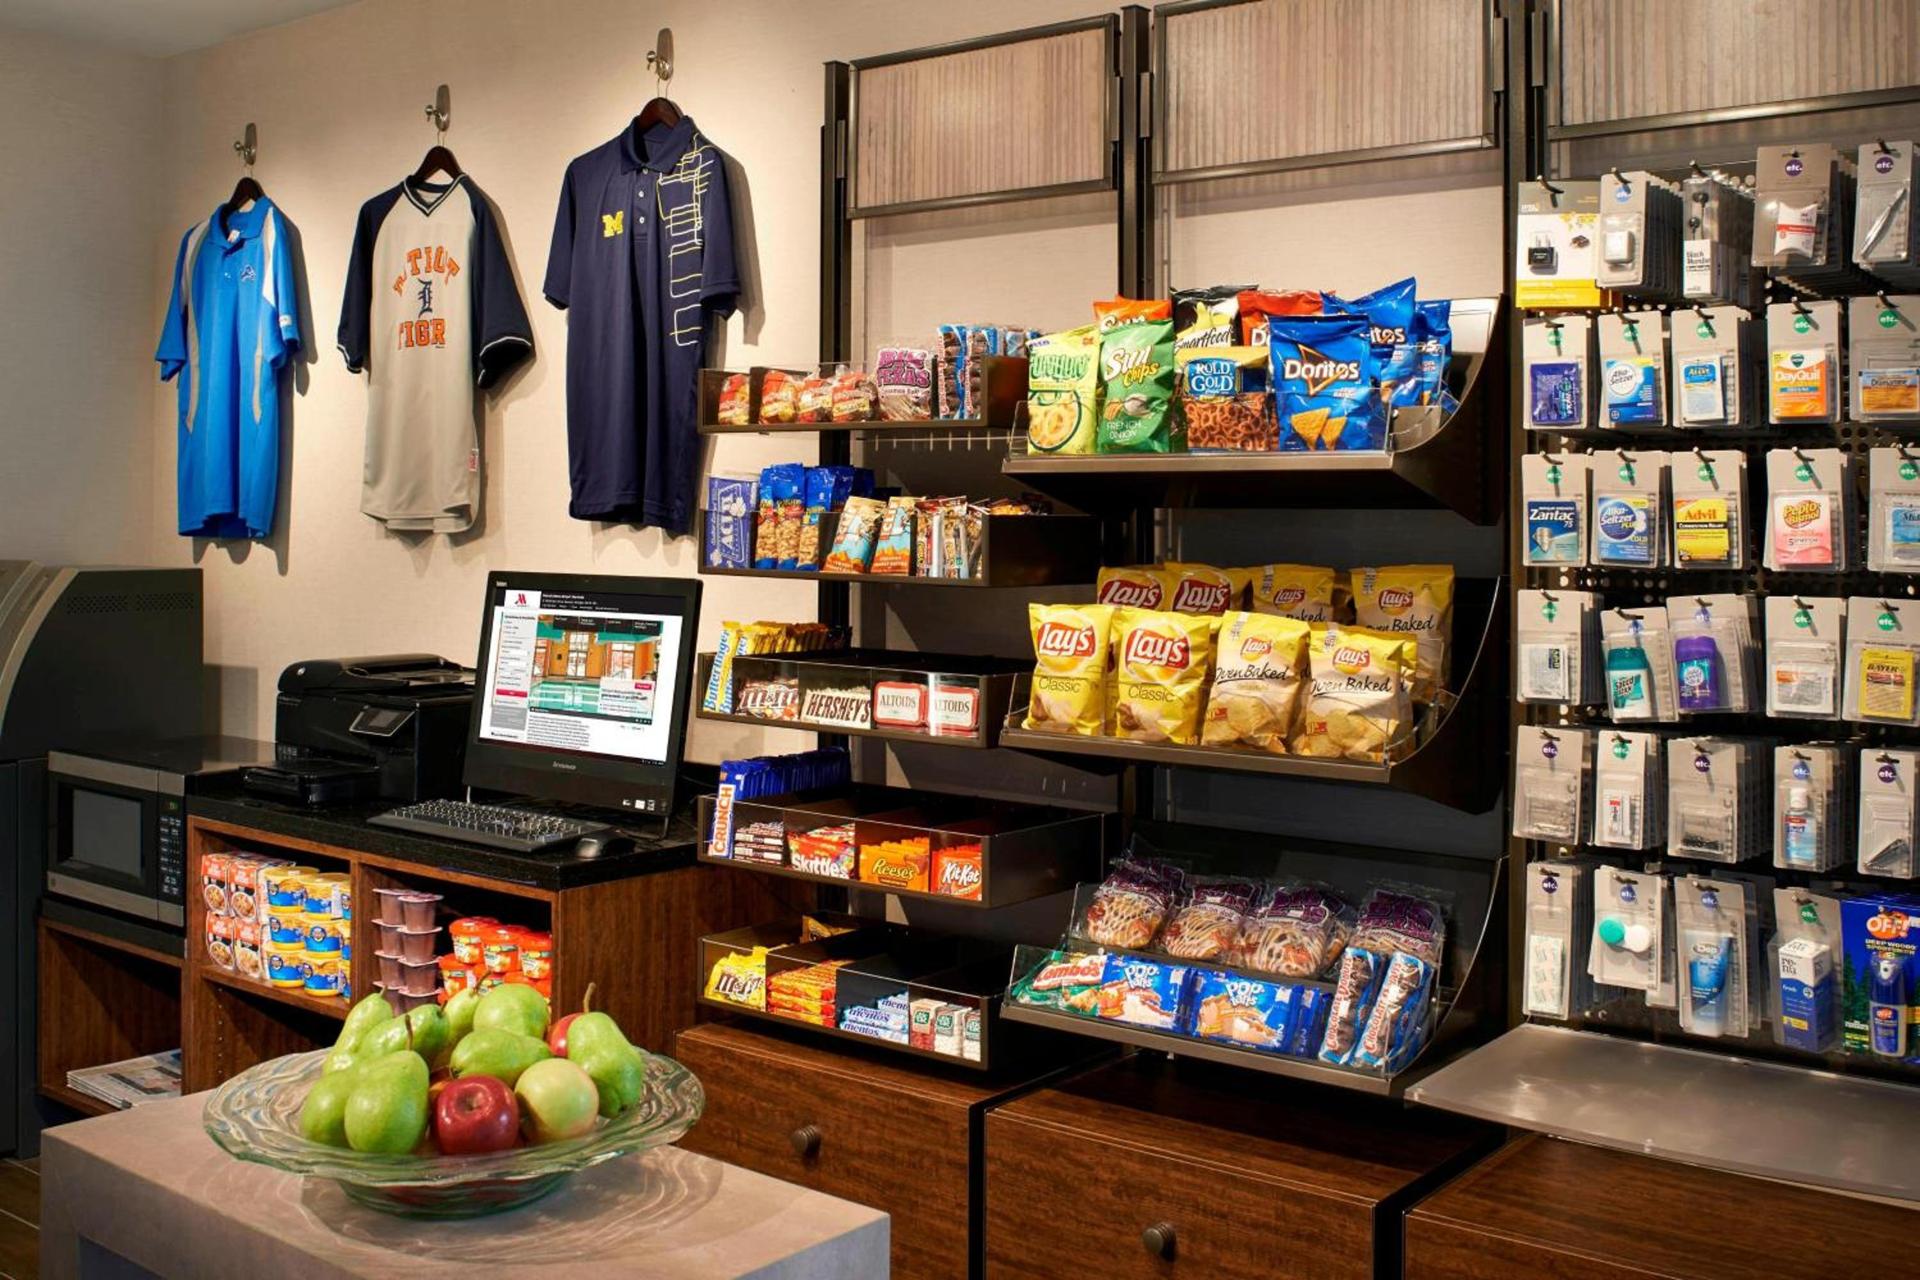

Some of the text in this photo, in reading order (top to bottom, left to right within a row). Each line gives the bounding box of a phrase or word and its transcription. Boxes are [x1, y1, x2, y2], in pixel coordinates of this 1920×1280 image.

[602, 211, 624, 237] M
[1195, 361, 1231, 375] ROLD
[1284, 359, 1360, 381] Doritos
[1776, 369, 1820, 383] DayQuil
[1191, 375, 1234, 392] GOLD
[1529, 508, 1574, 521] Zantac
[1684, 508, 1717, 521] Advil
[721, 514, 735, 549] ACT
[1563, 520, 1574, 528] 75
[1175, 581, 1229, 612] Lay's
[1275, 589, 1305, 602] Lay's
[1380, 590, 1413, 606] Lay's
[1392, 615, 1434, 631] Baked
[1039, 622, 1094, 656] Lay's
[1127, 628, 1187, 666] Lay's
[1334, 647, 1370, 666] Lay's
[703, 630, 731, 711] Butterfinger
[1243, 663, 1288, 681] Baked
[1038, 677, 1081, 693] Classic
[1346, 676, 1392, 692] Baked
[880, 694, 916, 709] ALTOIDS
[1128, 685, 1174, 702] Classic
[806, 693, 871, 723] HERSHEY'S
[935, 699, 970, 713] LTOIDS
[714, 786, 732, 852] CRUNCH
[792, 853, 850, 880] Skittles
[872, 858, 914, 880] Reese's
[958, 864, 980, 886] Kat
[1866, 914, 1909, 939] OFF!
[848, 1008, 891, 1022] mentos
[844, 1022, 880, 1037] mentos
